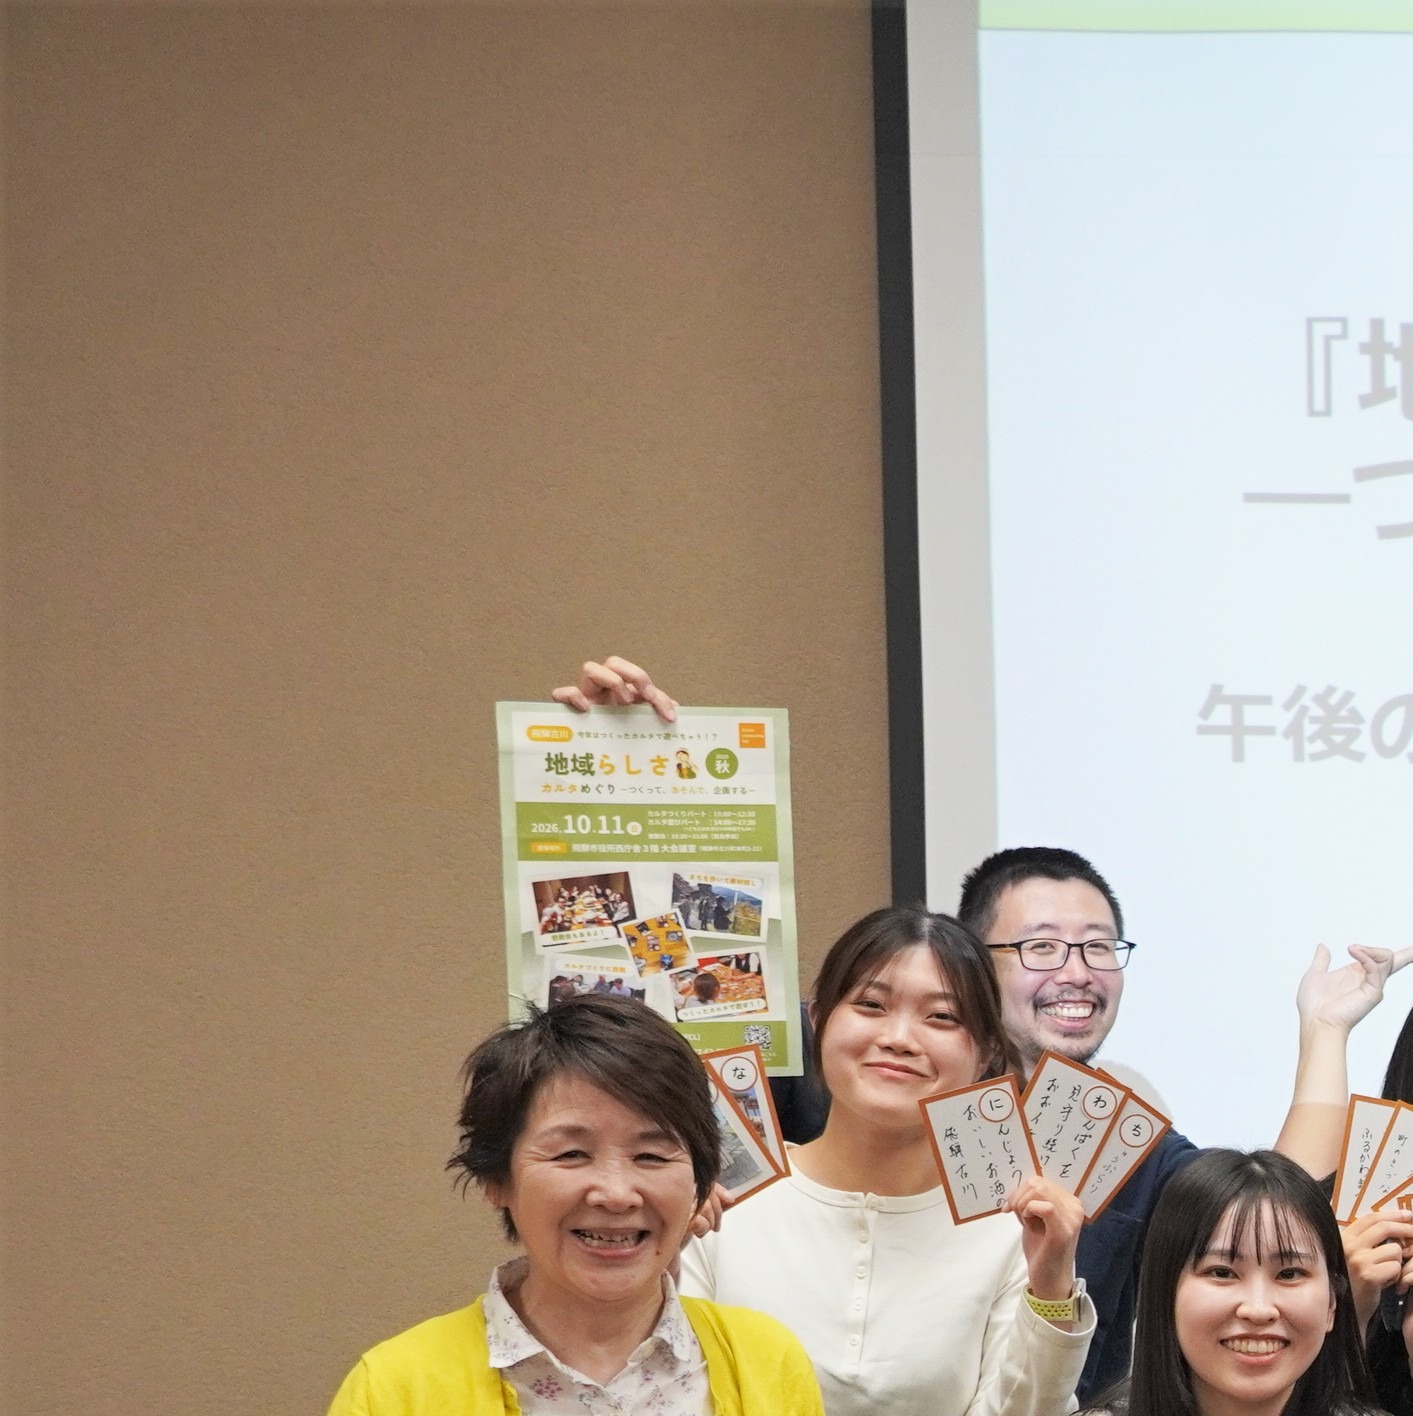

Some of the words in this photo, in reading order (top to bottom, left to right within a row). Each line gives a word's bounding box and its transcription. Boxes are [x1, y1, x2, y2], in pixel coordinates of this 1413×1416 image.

[545, 752, 669, 776] 地域らしさ
[715, 759, 729, 774] 秋
[542, 784, 615, 794] カルタめぐり
[732, 1066, 746, 1081] な
